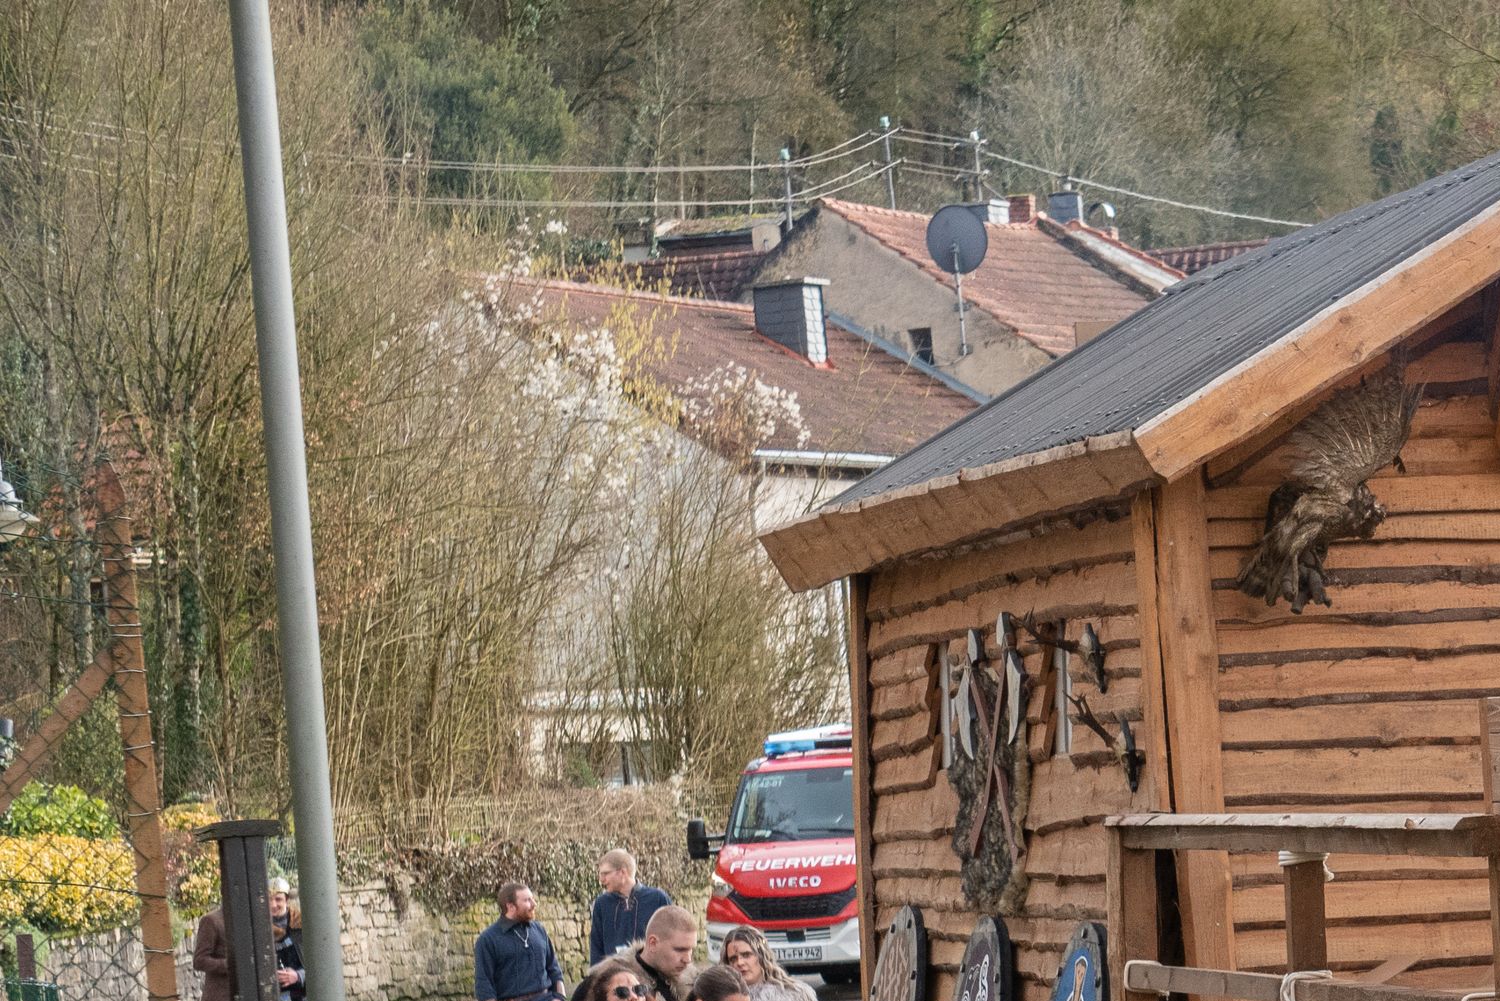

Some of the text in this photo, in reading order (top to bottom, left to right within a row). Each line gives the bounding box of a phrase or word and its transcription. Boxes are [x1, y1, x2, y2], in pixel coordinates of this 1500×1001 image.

[730, 854, 857, 874] FEUERWEH
[769, 875, 822, 889] IVECO
[804, 947, 820, 958] 942
